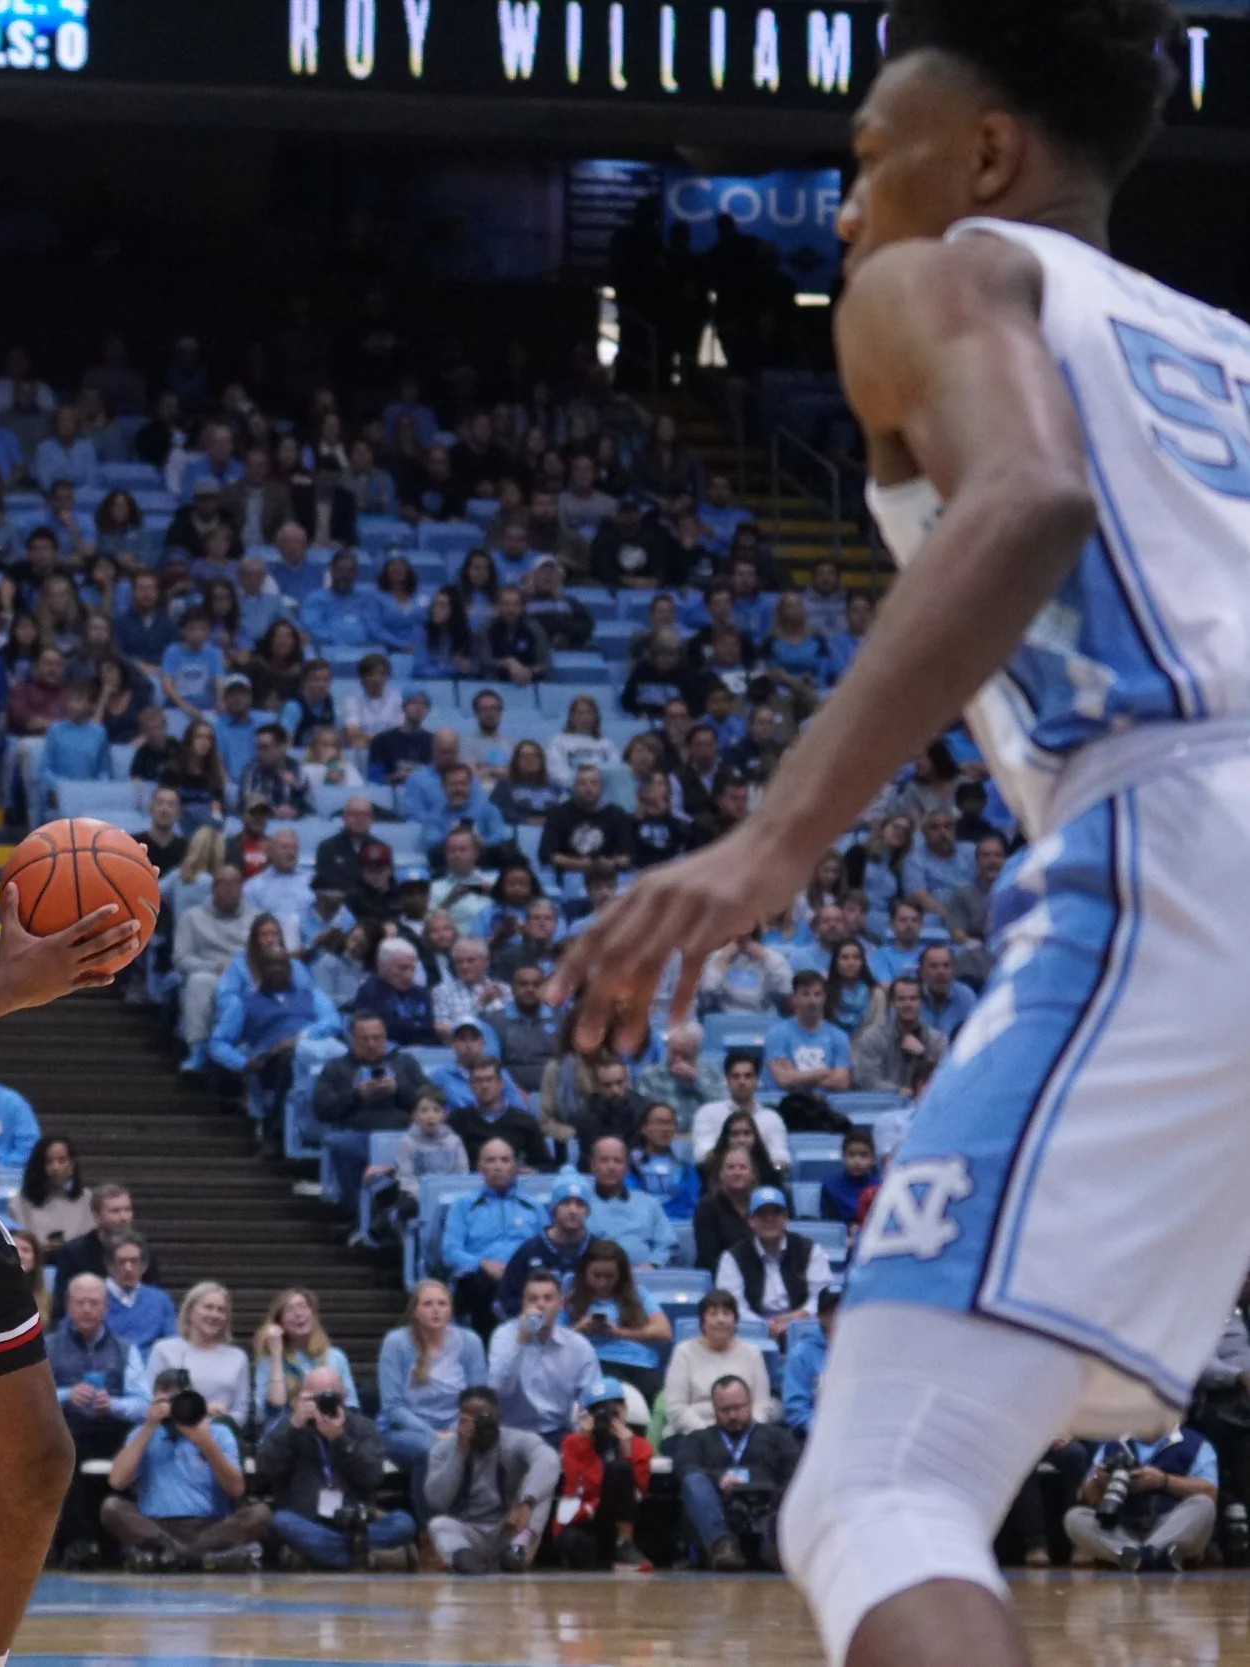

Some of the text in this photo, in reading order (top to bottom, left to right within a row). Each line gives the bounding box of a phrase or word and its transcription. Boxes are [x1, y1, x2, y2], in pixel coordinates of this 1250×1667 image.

[55, 20, 88, 71] 0
[289, 0, 431, 80] ROY
[497, 0, 889, 94] WILLIAM
